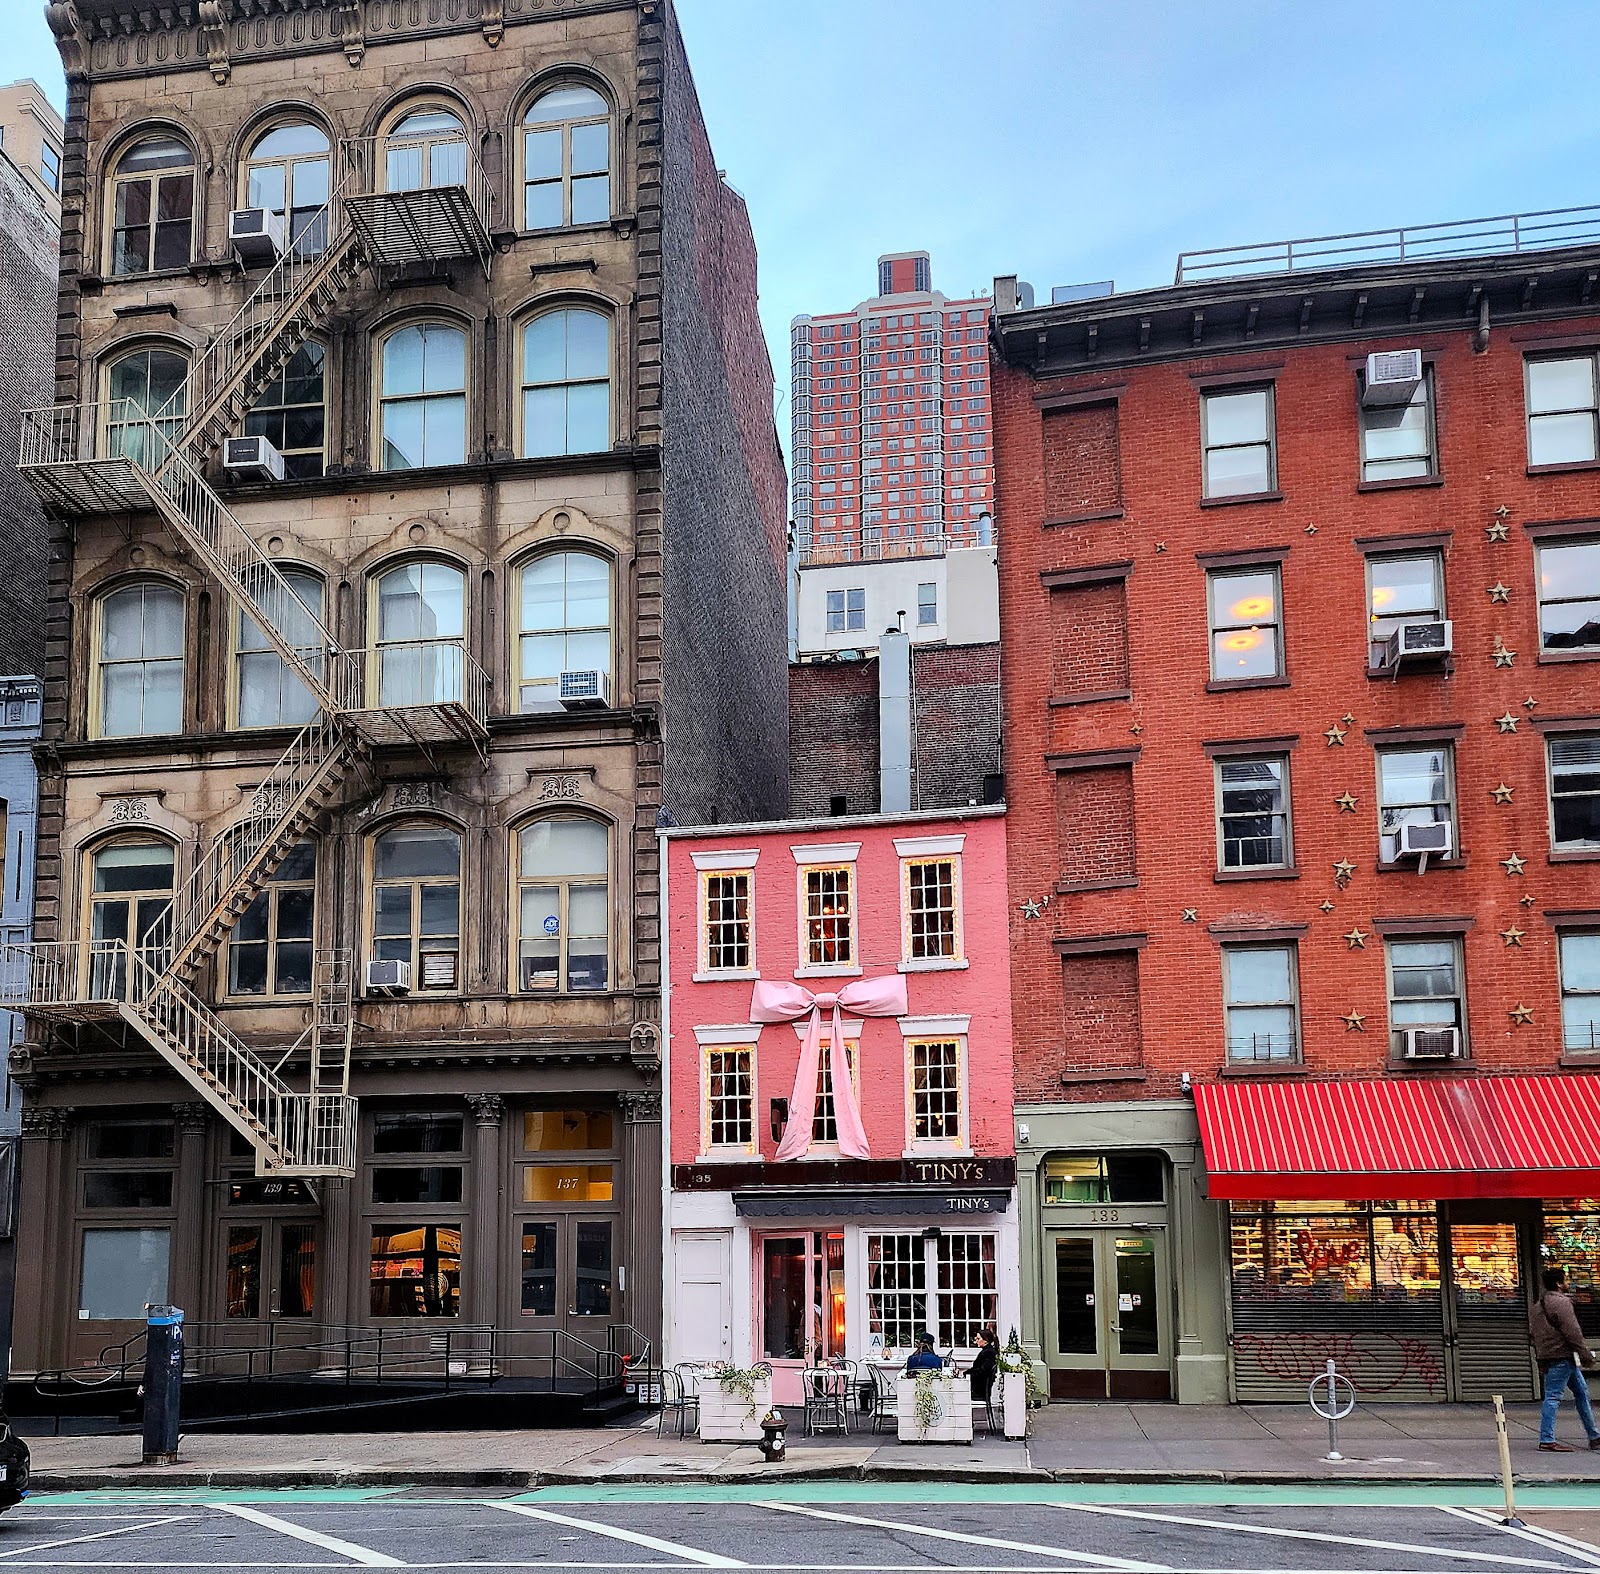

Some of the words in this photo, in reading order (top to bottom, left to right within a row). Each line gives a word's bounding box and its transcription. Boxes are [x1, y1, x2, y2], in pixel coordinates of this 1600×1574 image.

[916, 1163, 984, 1181] TINY's
[264, 1183, 283, 1193] 139
[557, 1178, 579, 1189] 137
[946, 1198, 989, 1209] TINY's
[1091, 1210, 1119, 1222] 133
